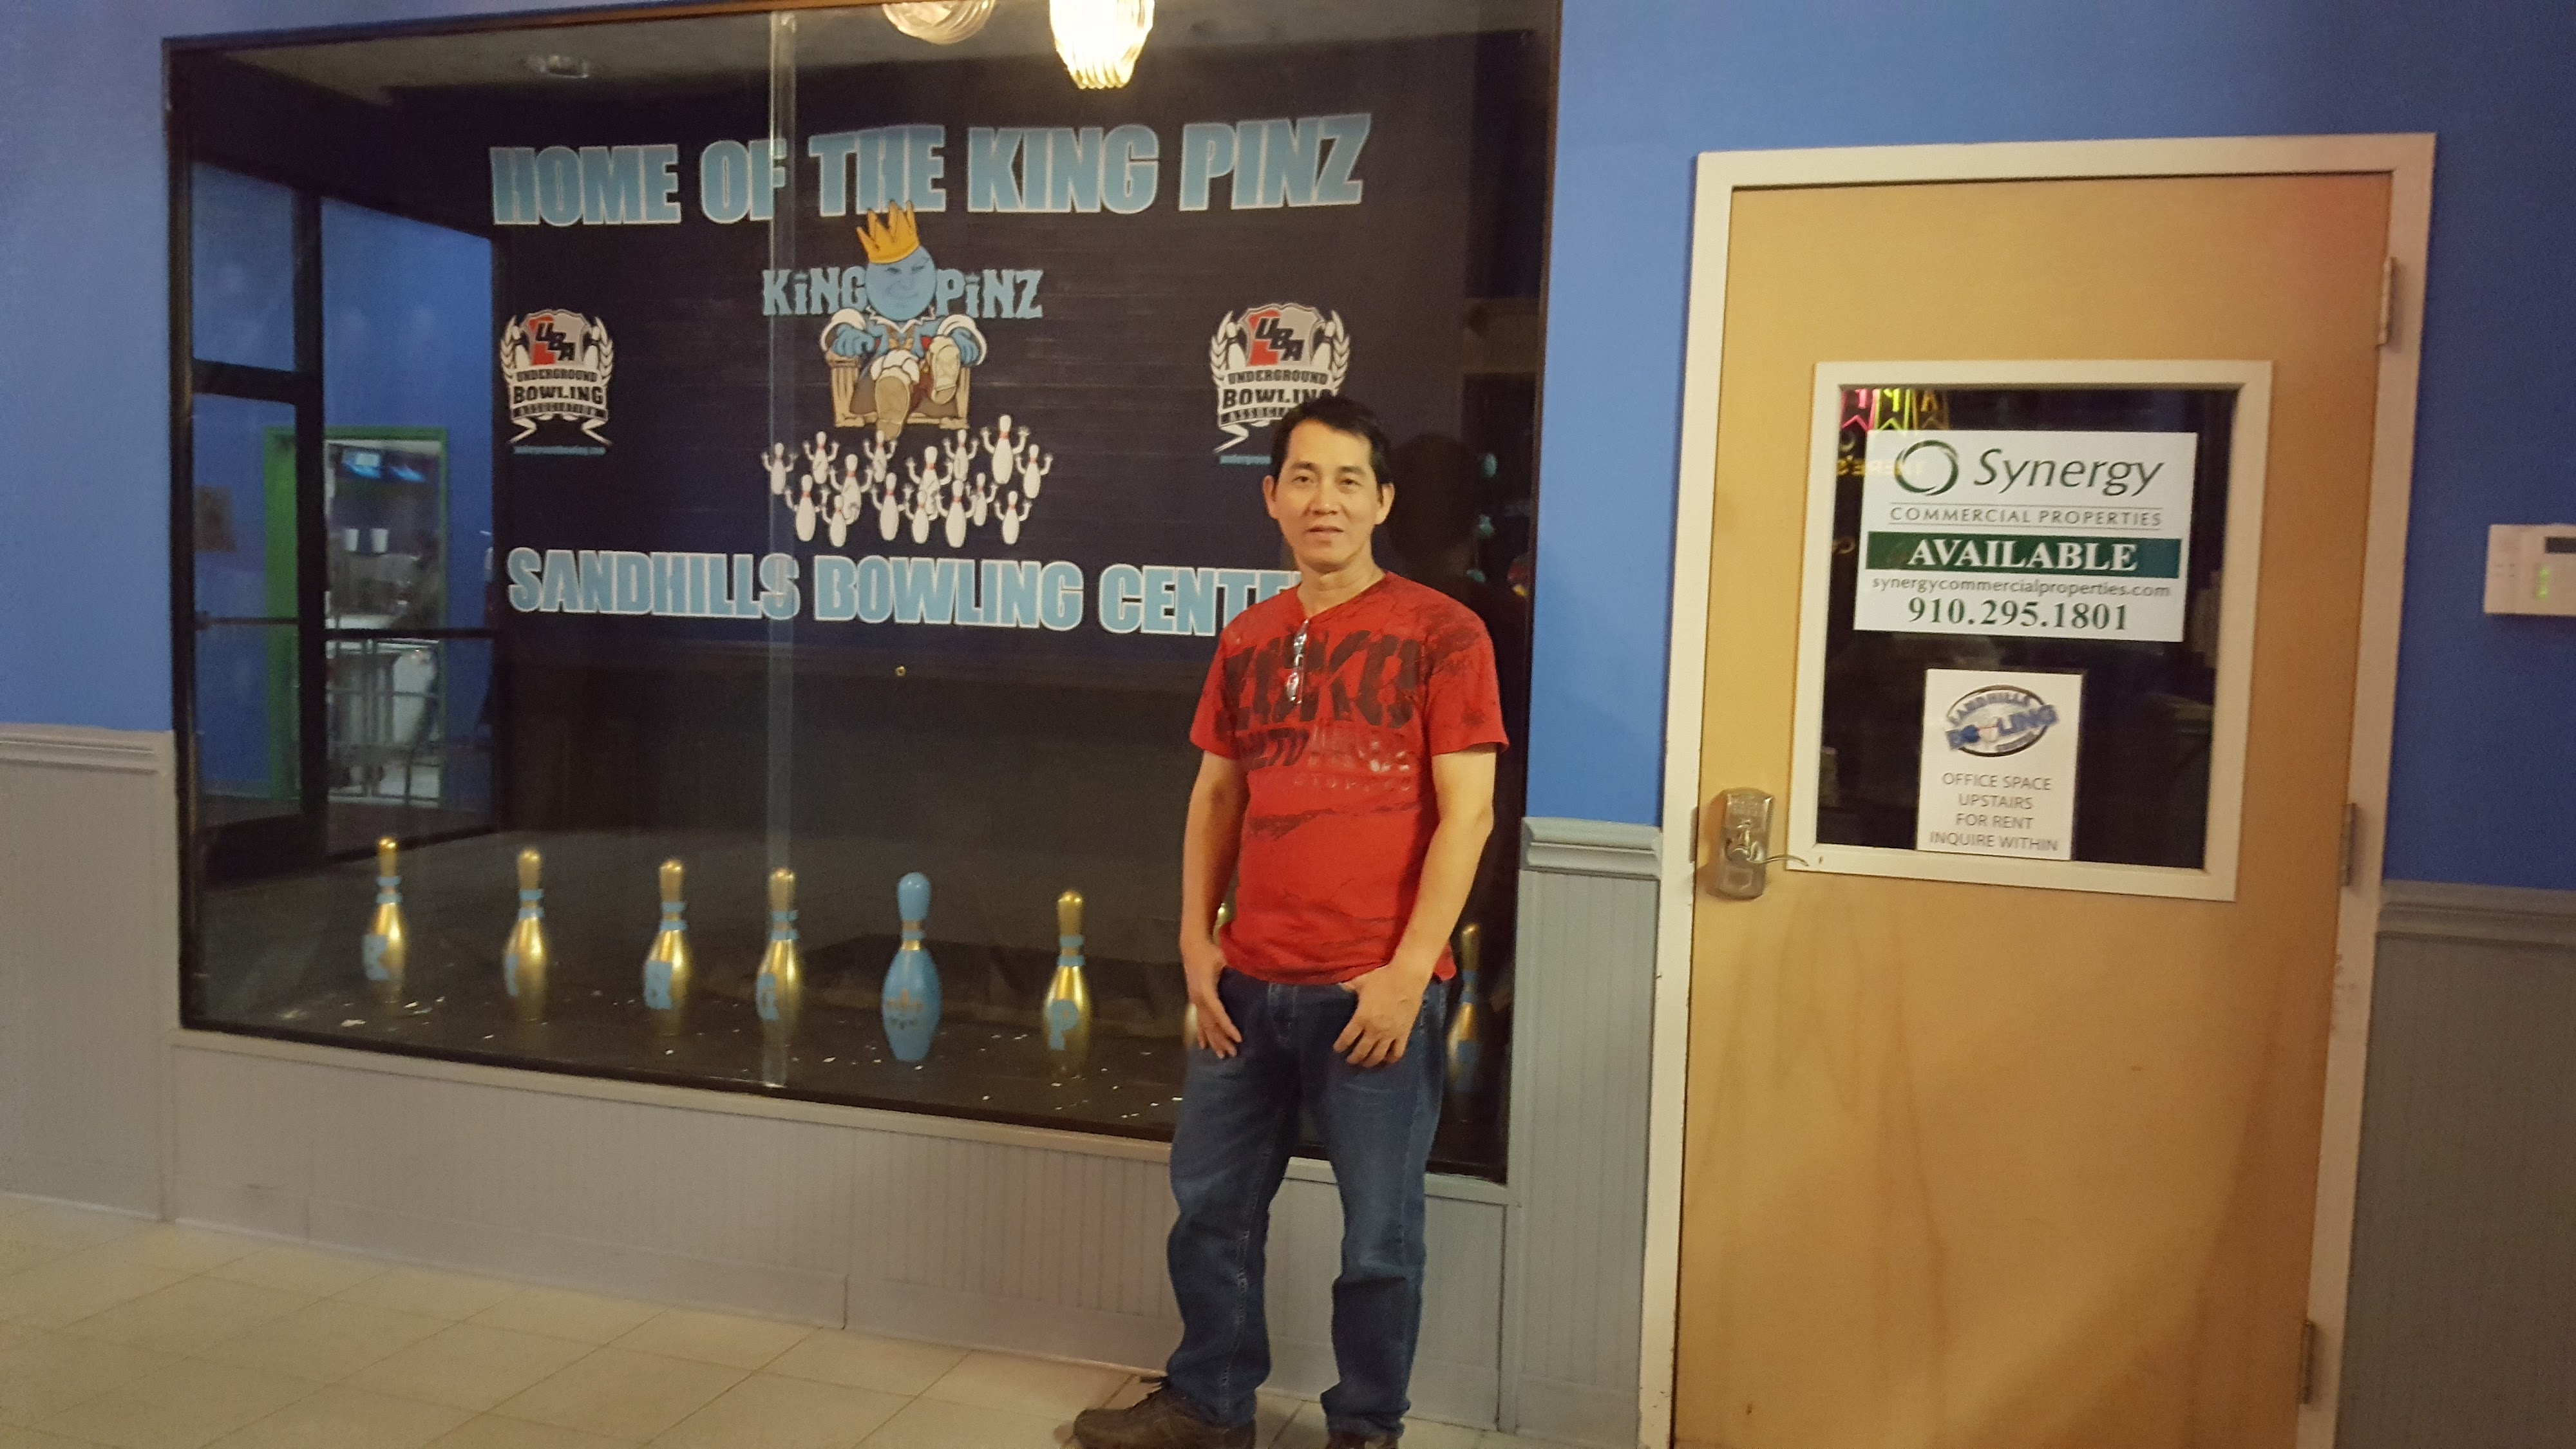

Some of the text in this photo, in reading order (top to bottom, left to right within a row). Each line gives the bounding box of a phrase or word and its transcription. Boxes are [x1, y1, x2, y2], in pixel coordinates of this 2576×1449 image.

[489, 113, 1372, 226] HOME OF THE KING PINZ
[1227, 369, 1328, 384] UNDERGROUND
[514, 386, 603, 404] BOWLING
[1973, 448, 2164, 497] Synergy
[1889, 507, 2161, 527] COMMERCIAL PROPERTIES
[1907, 538, 2139, 572] AVAILABLE
[507, 547, 1301, 637] SANDHILLS BOWLING CENT
[1871, 575, 2172, 598] synergycommercialproperties.com
[1908, 596, 2127, 631] 910.295.1801
[1942, 772, 2053, 791] OFFICE SPACE
[1958, 793, 2034, 810] UPSTAIRS
[1955, 813, 2034, 829] FOR RENT
[1929, 831, 2058, 851] INQUIRE WITHIN
